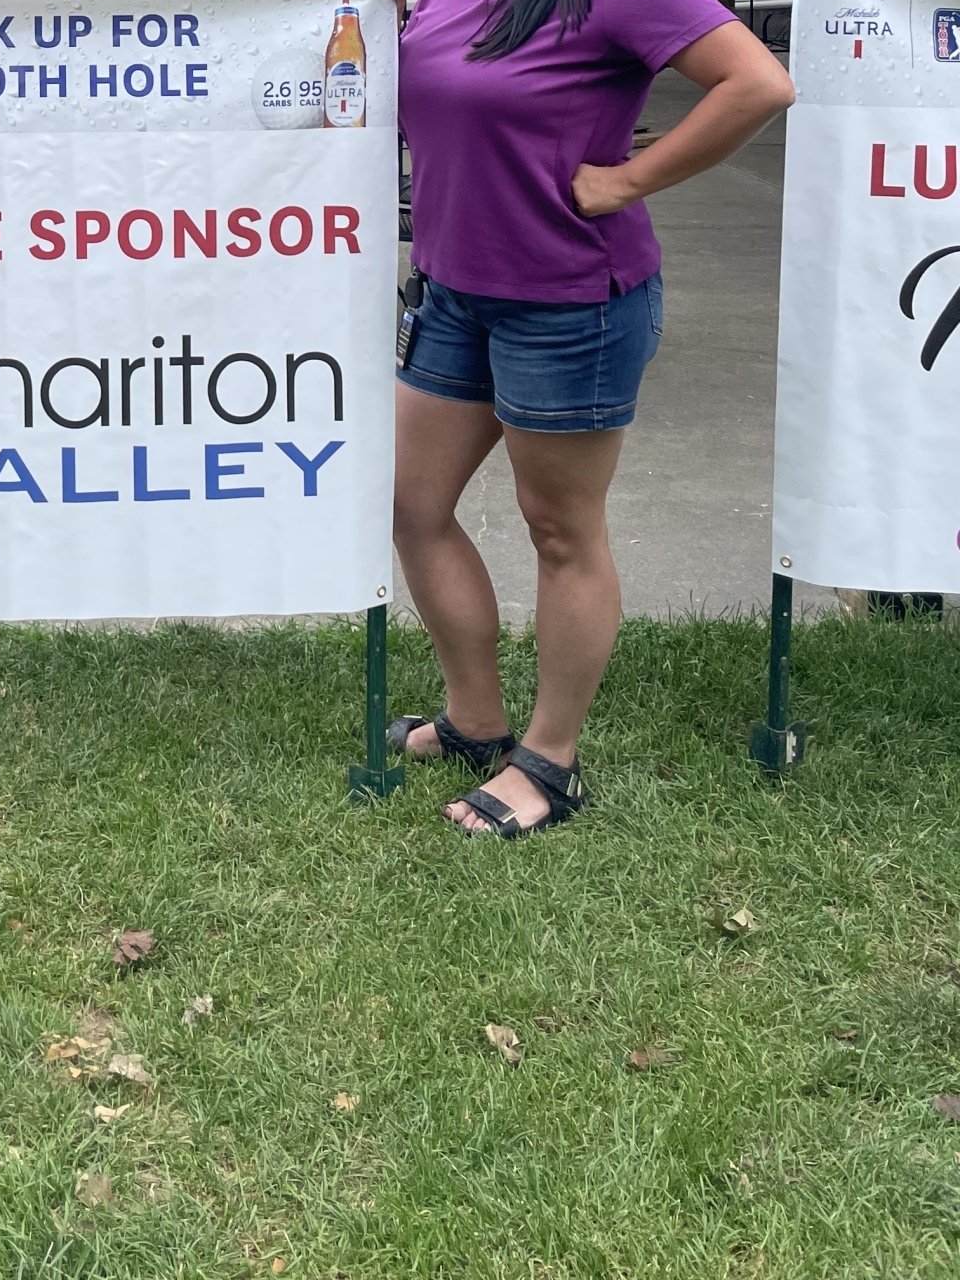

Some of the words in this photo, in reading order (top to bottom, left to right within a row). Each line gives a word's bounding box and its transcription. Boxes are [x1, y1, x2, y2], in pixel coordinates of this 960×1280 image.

[835, 8, 880, 18] Michelob
[34, 15, 92, 48] UP
[112, 14, 200, 47] FOR
[825, 21, 893, 35] ULTRA
[937, 22, 949, 58] TOUR
[89, 63, 208, 97] HOLE
[263, 81, 291, 98] 2.6
[299, 80, 322, 97] 95
[327, 87, 363, 99] ULTRA
[28, 205, 362, 261] SPONSOR
